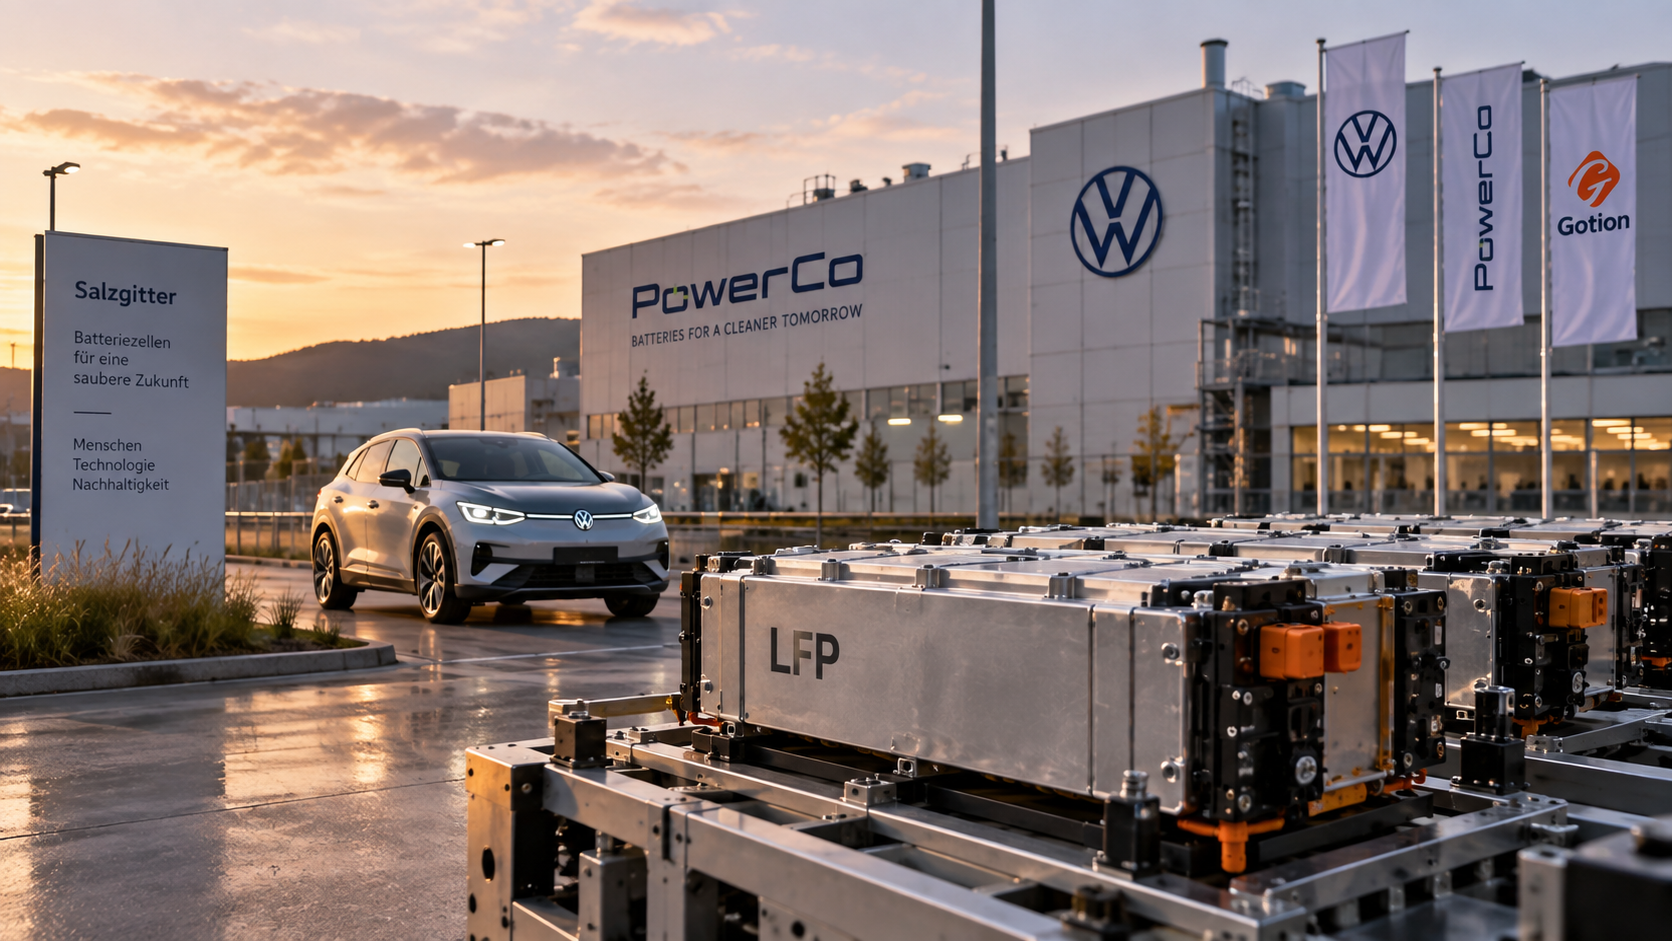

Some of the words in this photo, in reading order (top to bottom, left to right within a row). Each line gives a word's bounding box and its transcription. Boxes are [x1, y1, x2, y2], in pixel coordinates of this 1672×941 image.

[1473, 105, 1494, 291] PowerCo
[1557, 213, 1630, 236] Gotion
[75, 281, 177, 307] Salzgitter
[632, 252, 863, 319] PowerCo
[631, 328, 684, 347] BATTERIES
[688, 324, 710, 340] FOR
[712, 323, 721, 337] A
[724, 316, 778, 336] CLEANER
[782, 303, 863, 328] TOMORROW
[74, 330, 171, 349] Batteriezellen
[73, 350, 95, 365] für
[99, 353, 129, 366] eine
[73, 372, 131, 387] saubere
[135, 374, 189, 389] Zukunft
[73, 438, 142, 452] Menschen
[73, 457, 155, 474] Technologie
[72, 477, 170, 493] Nachhaltigkeit
[770, 627, 840, 680] LFP
